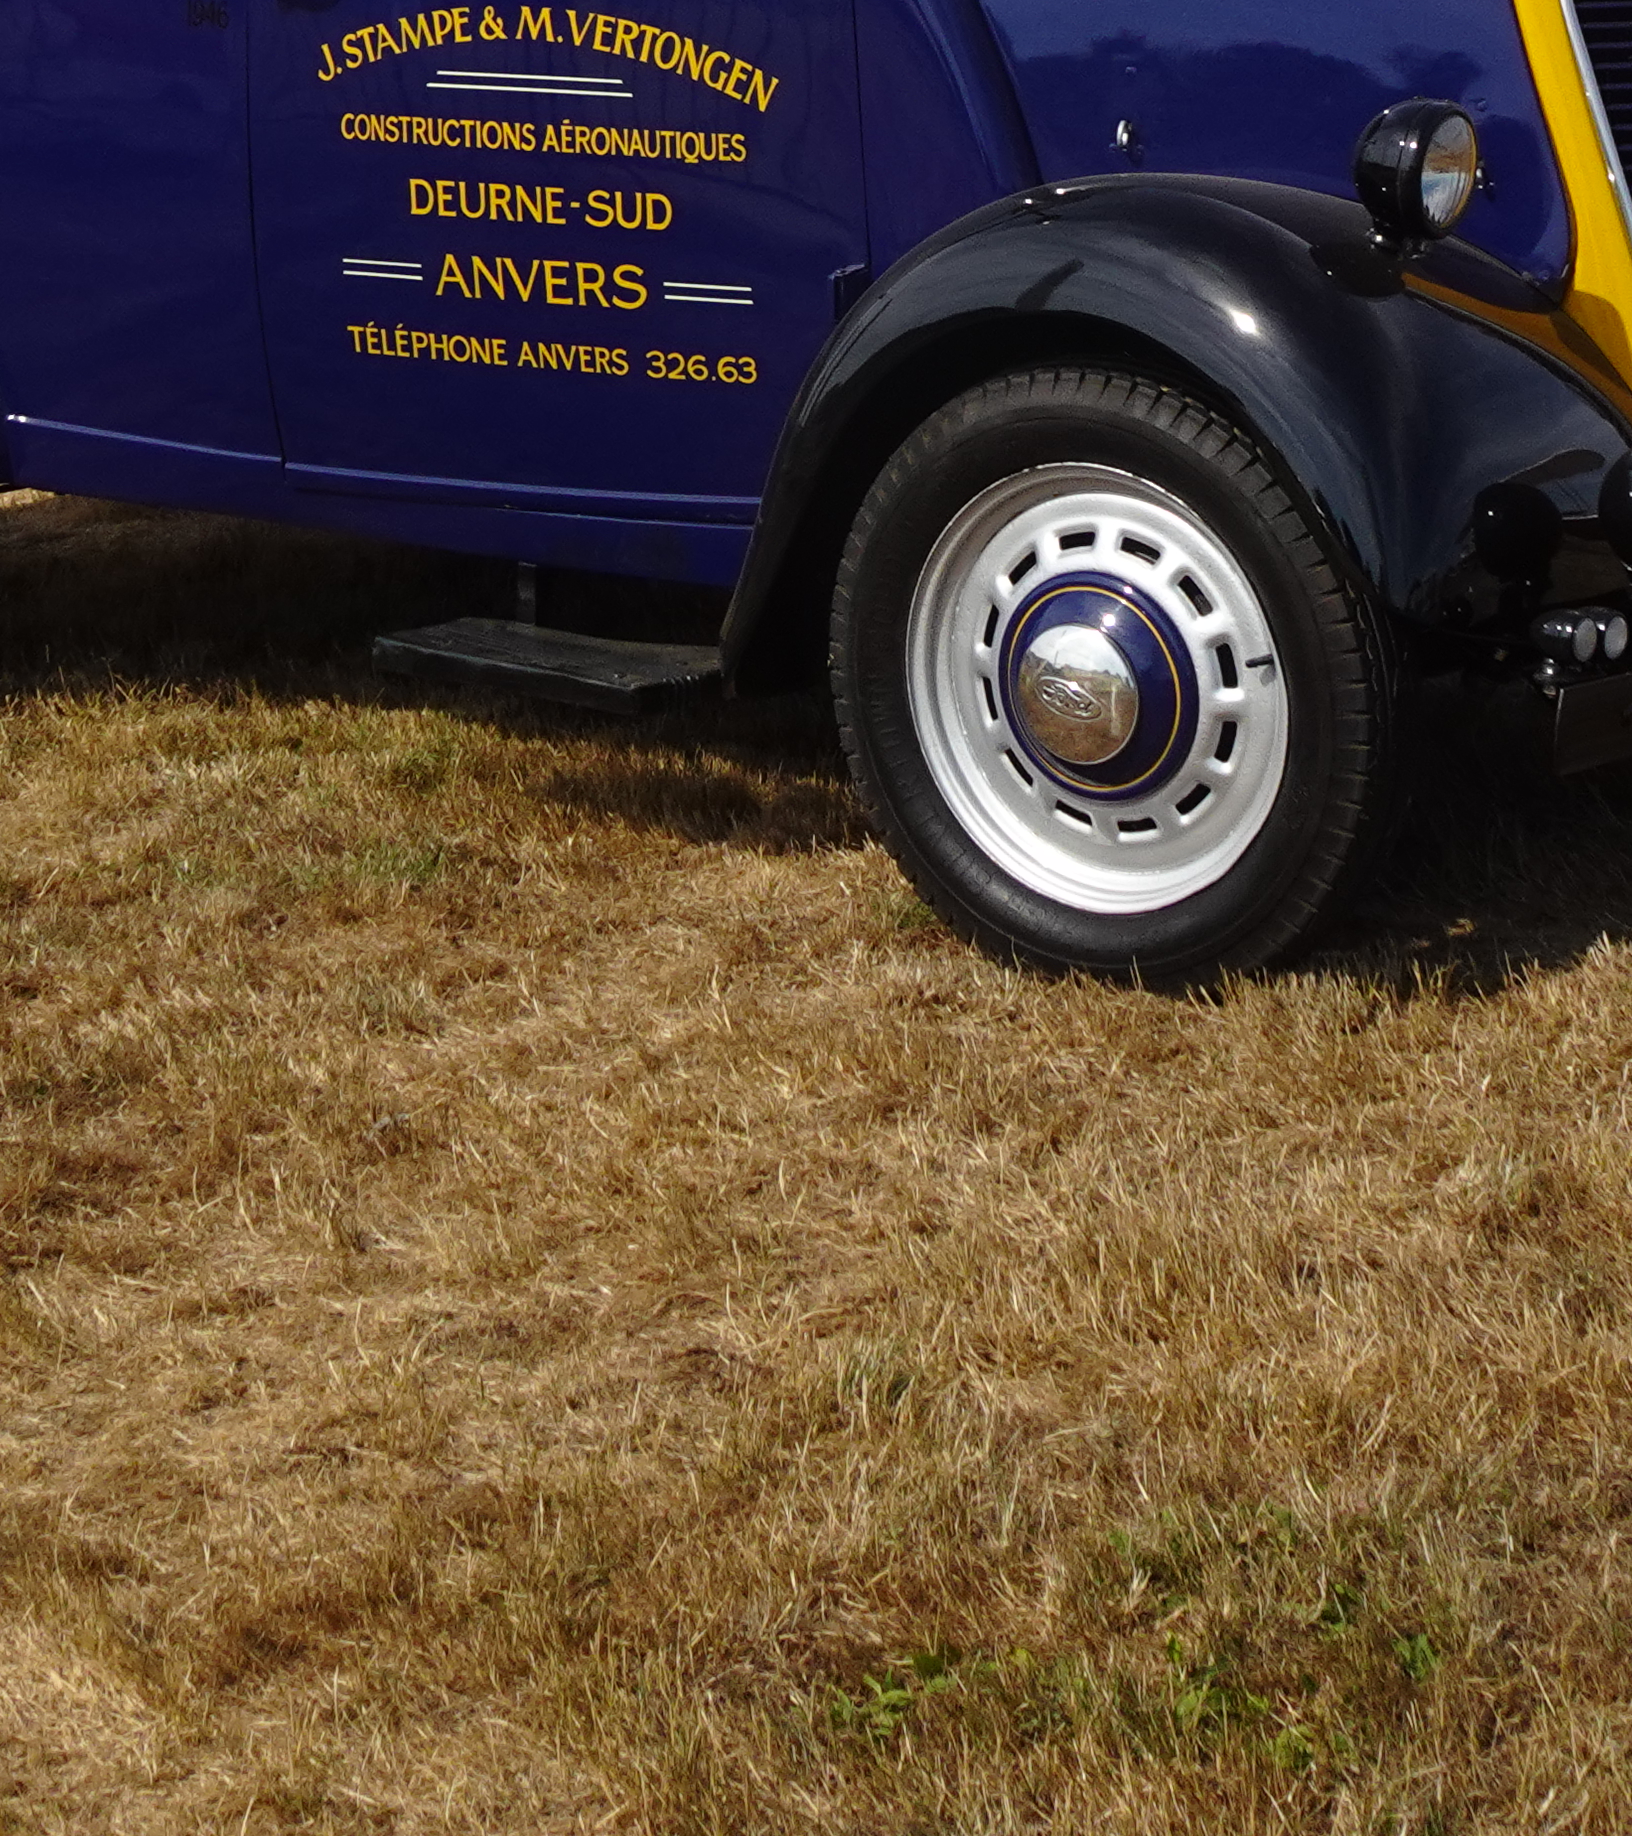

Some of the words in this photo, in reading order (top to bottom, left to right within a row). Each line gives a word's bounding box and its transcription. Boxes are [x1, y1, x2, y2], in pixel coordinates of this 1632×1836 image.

[479, 5, 508, 41] &
[340, 112, 536, 152] CONSTRUCTIONS
[541, 119, 747, 164] AÉRONAUTIQUES
[409, 178, 673, 231] DEURNE-SUD
[435, 253, 648, 310] ANVERS
[347, 321, 508, 367] TÉLÉPHONE
[517, 340, 629, 376] ANVERS
[645, 350, 758, 385] 326.63
